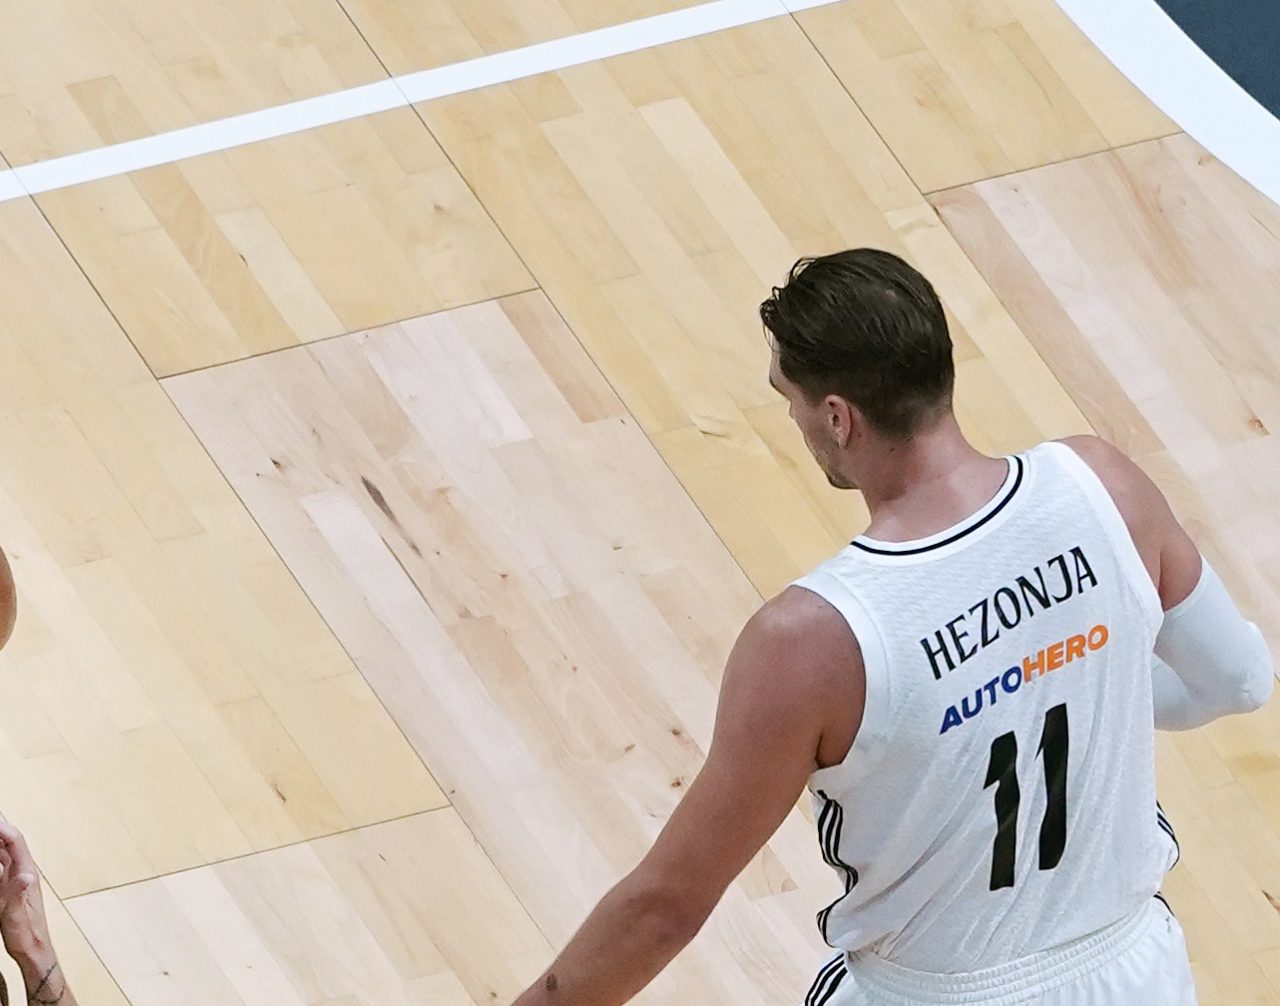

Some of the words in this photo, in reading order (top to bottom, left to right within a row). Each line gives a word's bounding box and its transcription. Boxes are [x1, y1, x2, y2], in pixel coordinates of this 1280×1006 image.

[920, 546, 1099, 681] HEZONJA
[939, 624, 1109, 735] AUTOHERO
[983, 702, 1070, 892] 11
